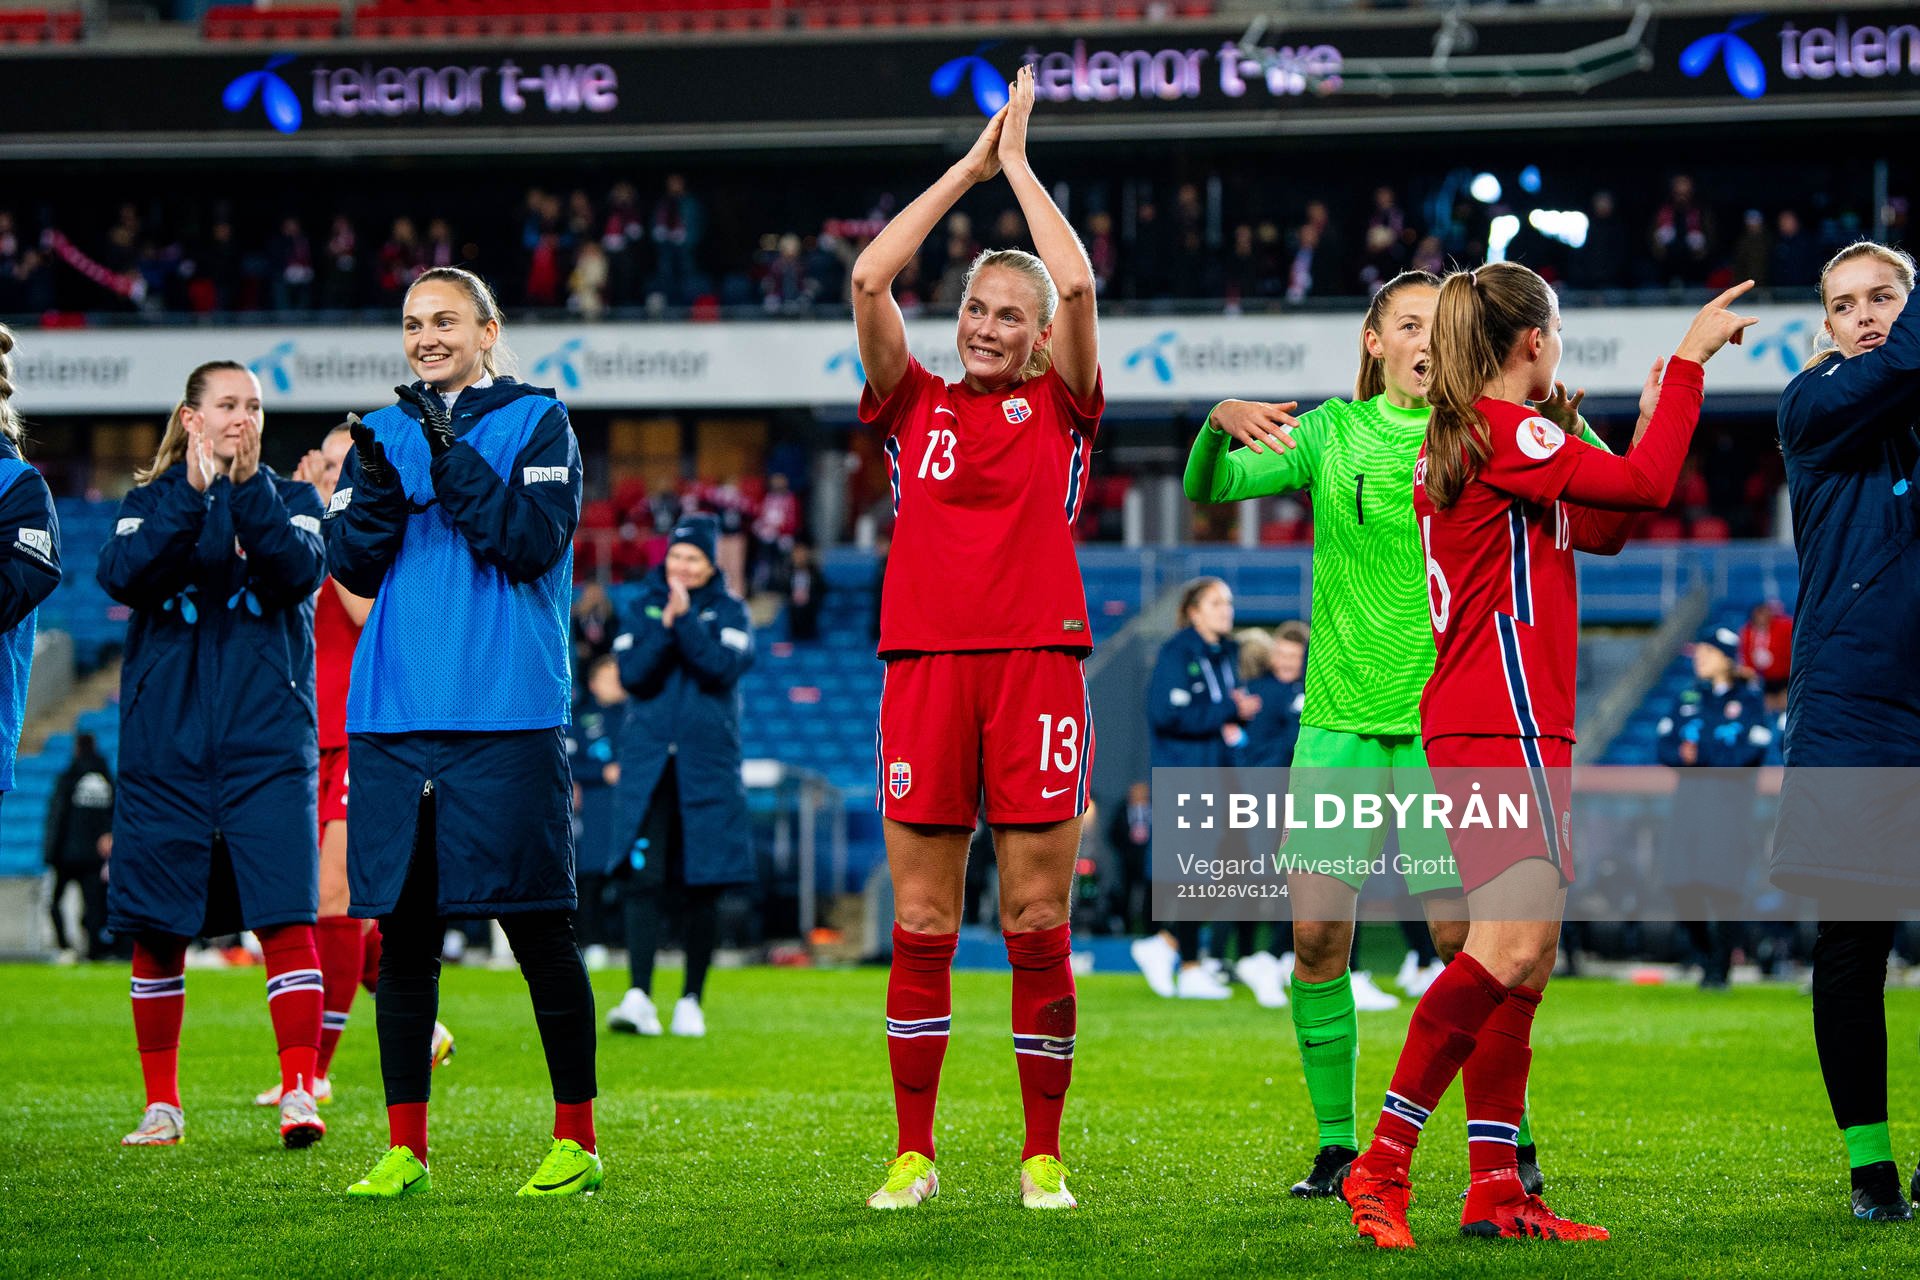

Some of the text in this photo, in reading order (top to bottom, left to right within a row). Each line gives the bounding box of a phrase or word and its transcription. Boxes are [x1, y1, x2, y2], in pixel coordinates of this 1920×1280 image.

[312, 58, 618, 117] telenor t-we
[297, 347, 411, 385] teleno
[585, 343, 708, 382] telenor
[1176, 335, 1308, 374] telenor
[529, 467, 563, 483] DNB
[918, 429, 957, 480] 13
[1354, 473, 1364, 525] 1
[1038, 713, 1078, 773] 13
